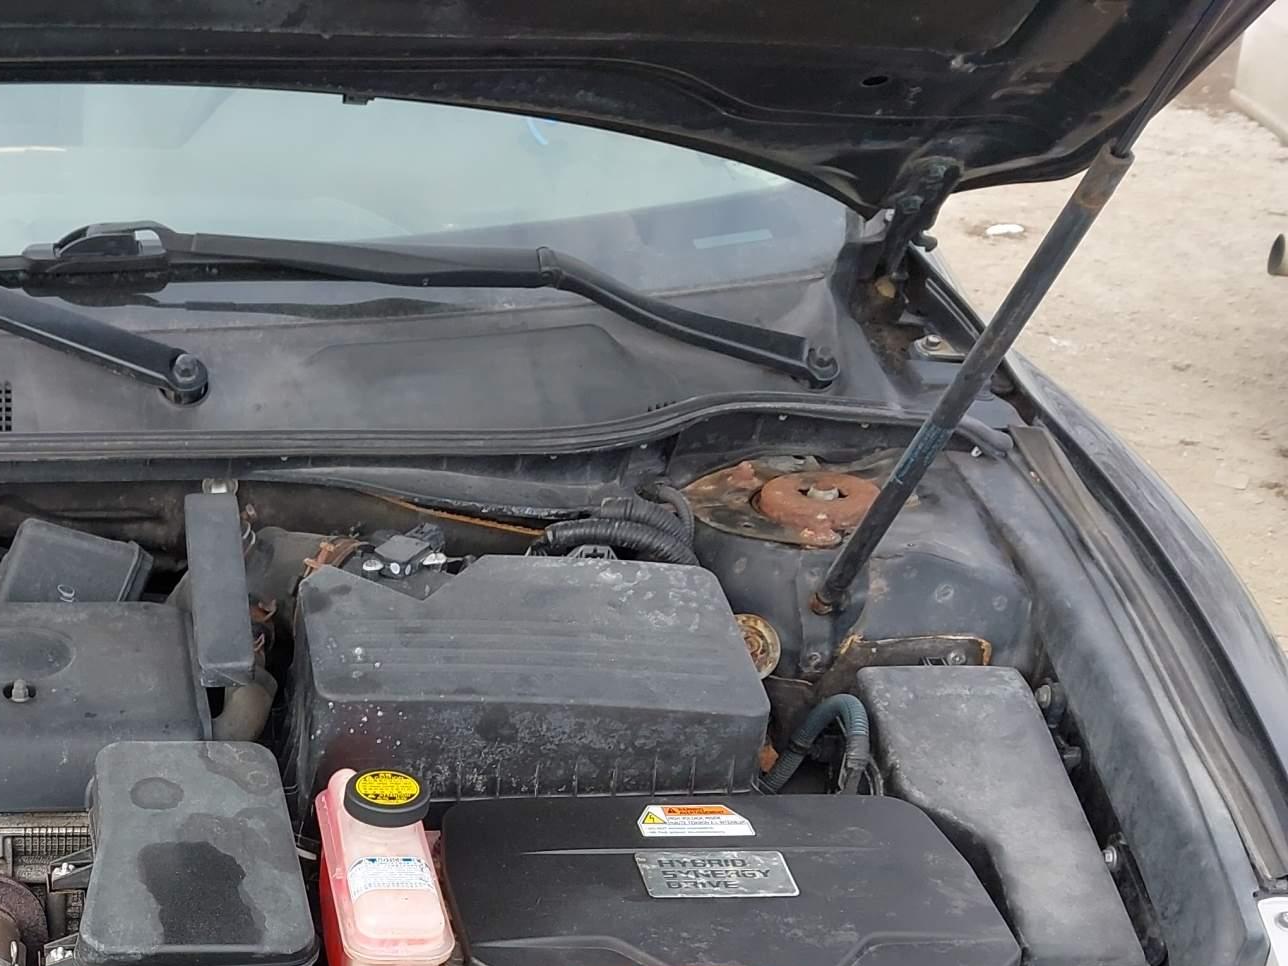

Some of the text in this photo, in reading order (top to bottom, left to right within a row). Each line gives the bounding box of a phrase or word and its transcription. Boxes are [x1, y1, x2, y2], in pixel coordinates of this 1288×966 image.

[657, 858, 747, 868] HYBRID
[661, 869, 771, 879] SYNERGY
[665, 880, 740, 889] DRIVE
